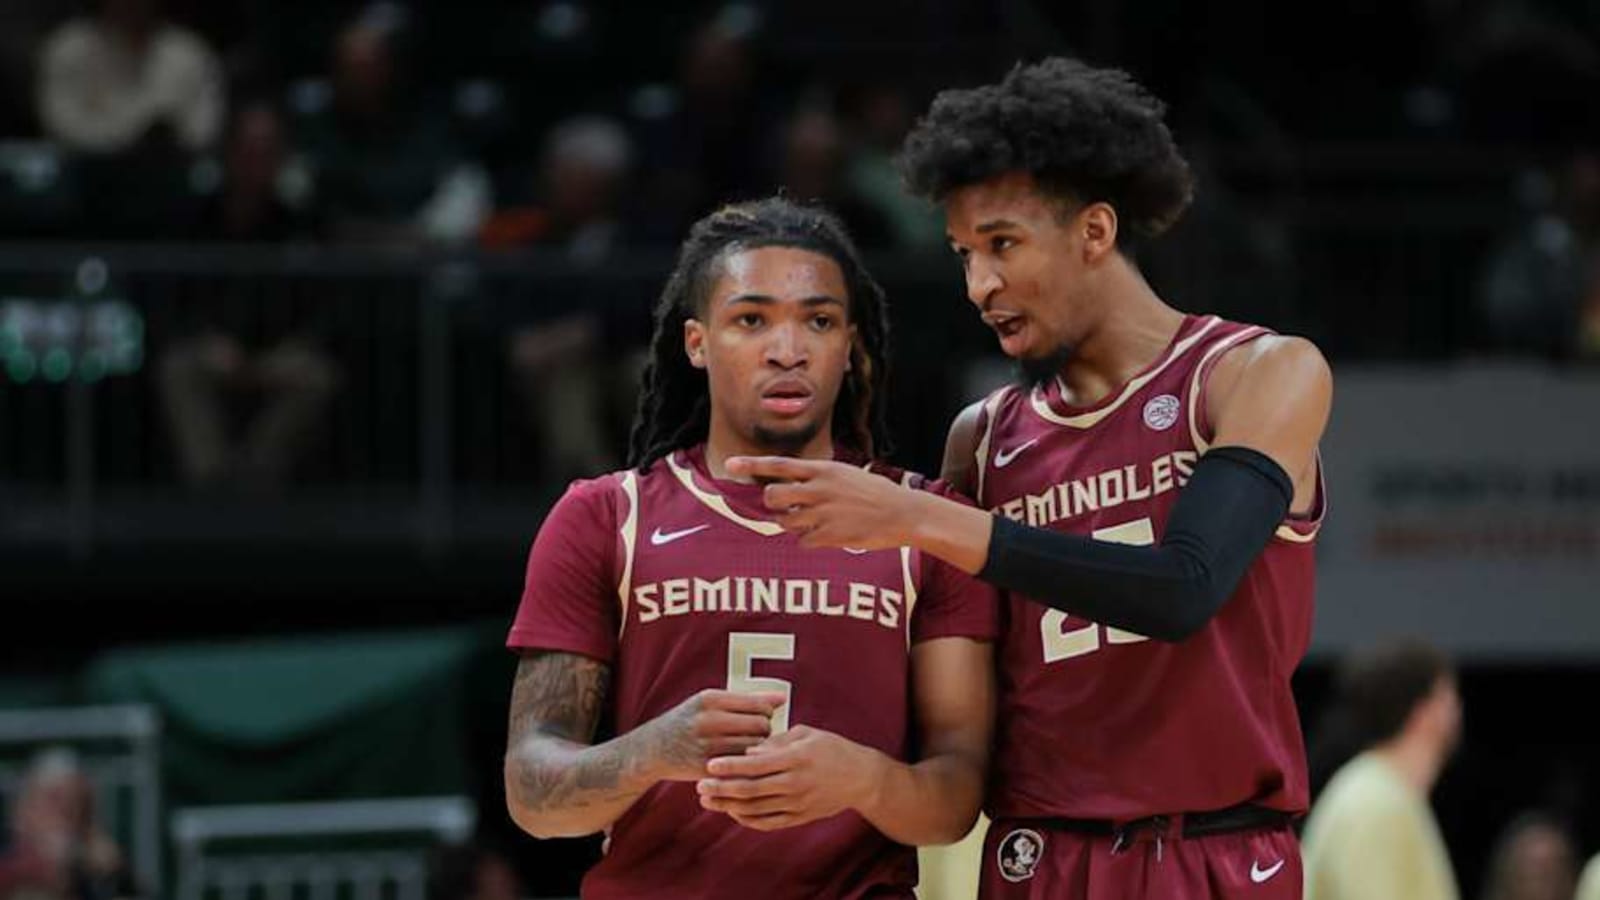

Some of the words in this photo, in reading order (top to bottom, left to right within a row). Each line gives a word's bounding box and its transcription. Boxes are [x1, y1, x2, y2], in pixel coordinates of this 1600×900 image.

[991, 451, 1198, 527] EMINOLES
[634, 576, 903, 629] SEMINOLES
[727, 632, 795, 734] 5
